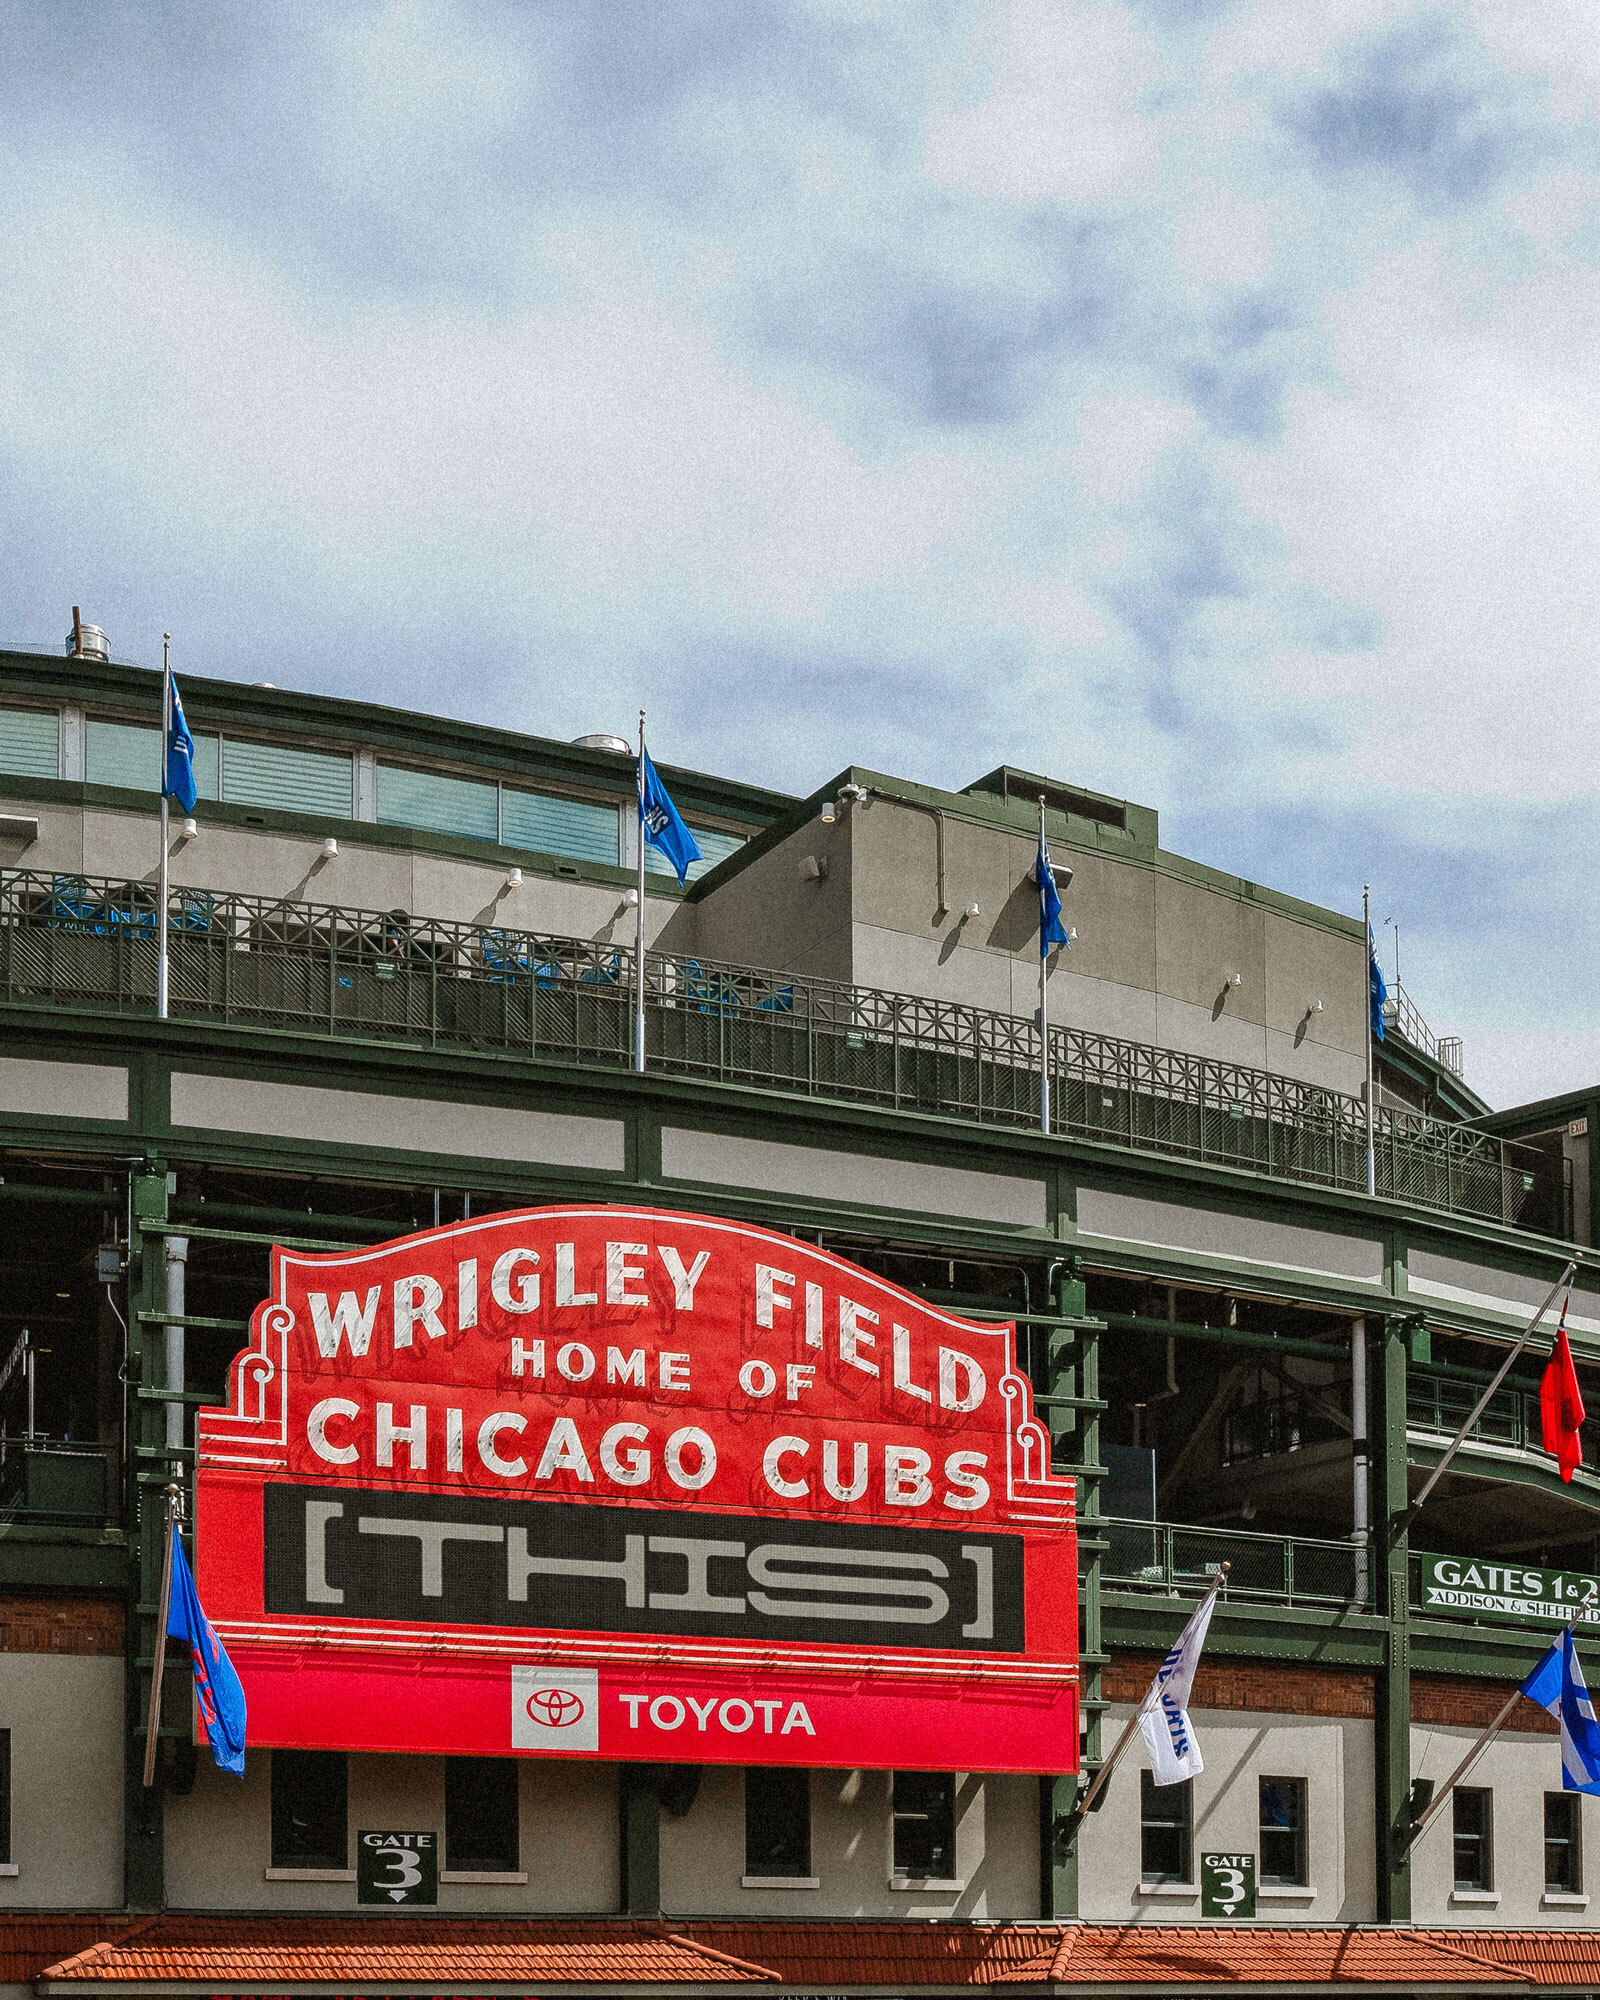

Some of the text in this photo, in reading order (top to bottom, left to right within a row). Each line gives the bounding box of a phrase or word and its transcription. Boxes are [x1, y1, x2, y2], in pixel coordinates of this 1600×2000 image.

[1570, 1120, 1585, 1134] EXIT
[307, 1241, 987, 1413] WRIGLEY FIELD
[511, 1337, 816, 1401] HOME OF
[307, 1397, 991, 1511] CHICAGO CUBS
[1433, 1560, 1543, 1596] GATES
[1434, 1590, 1505, 1610] ADDISON
[1510, 1600, 1521, 1612] &
[618, 1694, 817, 1736] TOYOTA
[363, 1834, 432, 1848] GATE
[373, 1848, 422, 1888] 3
[1205, 1855, 1252, 1868] GATE
[1212, 1868, 1246, 1903] 3
